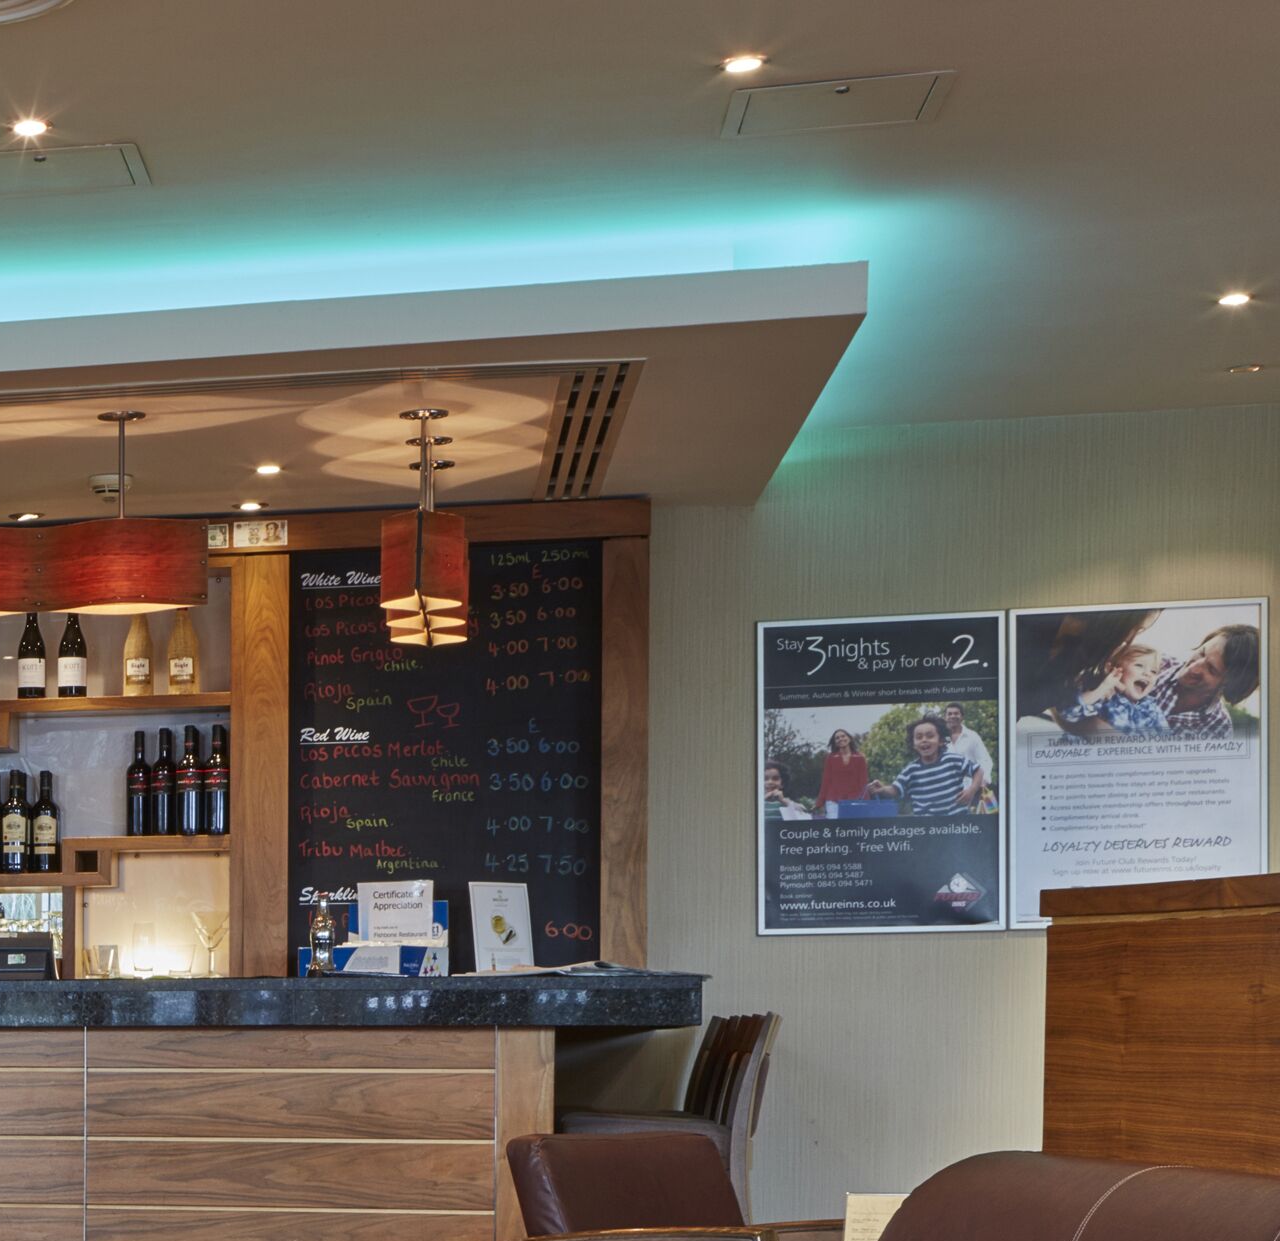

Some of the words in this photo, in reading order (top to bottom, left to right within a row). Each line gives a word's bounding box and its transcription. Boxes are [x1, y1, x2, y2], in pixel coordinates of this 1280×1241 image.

[300, 571, 342, 588] White
[346, 570, 383, 585] Wine
[776, 638, 805, 652] Stay
[805, 635, 827, 676] 3
[827, 637, 890, 662] nights
[857, 657, 869, 670] &
[872, 656, 897, 672] pay
[900, 655, 920, 668] for
[922, 653, 953, 670] only
[942, 685, 966, 694] Future
[300, 727, 330, 743] Red
[334, 727, 370, 742] Wine
[1105, 733, 1146, 745] REWARD
[1096, 745, 1153, 756] EXPERIENCE
[1156, 743, 1181, 754] WITH
[1183, 743, 1202, 754] THE
[1203, 741, 1244, 752] FAMILY
[299, 770, 380, 790] Cabernet
[388, 769, 481, 792] Sauvignon
[779, 828, 820, 840] Couple
[822, 827, 832, 838] &
[835, 826, 871, 840] family
[872, 824, 926, 839] packages
[779, 844, 804, 855] Free
[1043, 840, 1102, 854] LOYALTY
[1103, 837, 1170, 851] DESERVES
[1172, 835, 1233, 849] REWARD
[372, 889, 414, 900] Certificate
[373, 901, 423, 911] Appreciation
[779, 898, 897, 911] www.futureinns.co.uk
